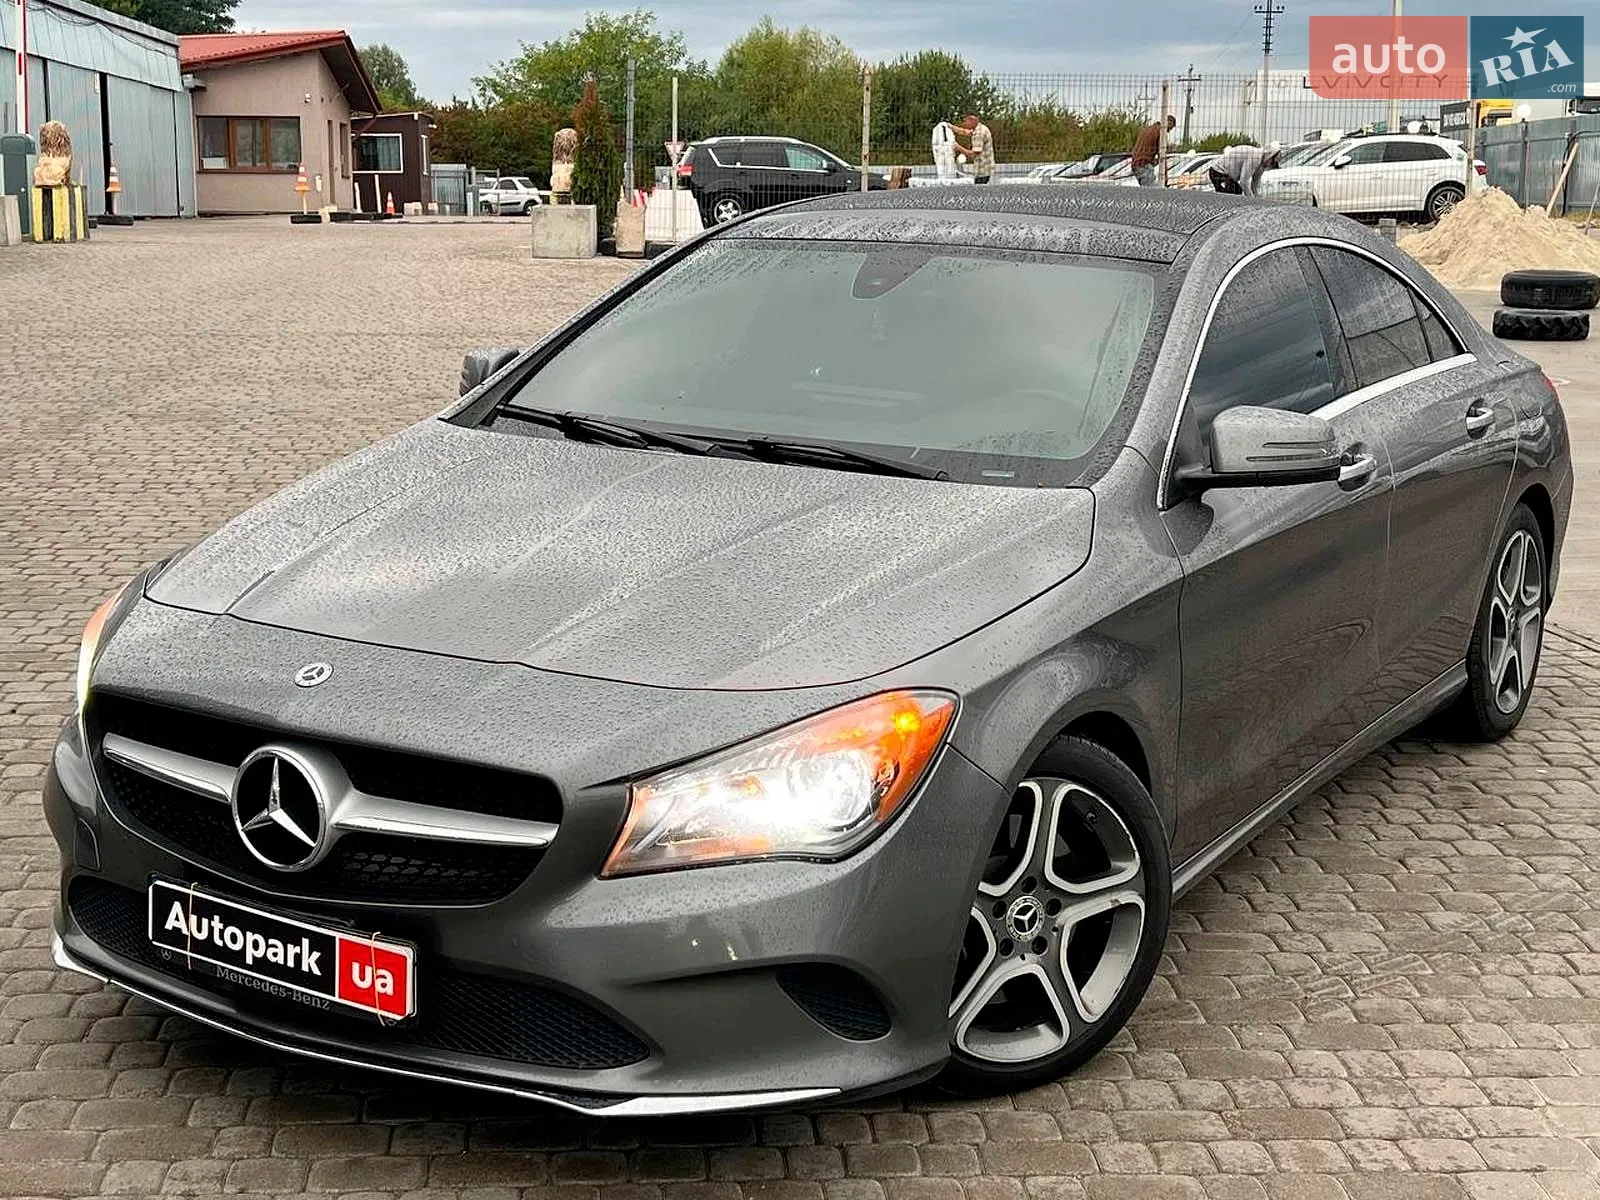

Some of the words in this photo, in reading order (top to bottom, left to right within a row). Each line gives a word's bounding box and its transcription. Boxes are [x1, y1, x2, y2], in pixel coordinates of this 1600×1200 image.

[164, 901, 322, 976] Autopark
[351, 961, 395, 997] ua
[215, 965, 331, 1010] Mercedes-Benz
